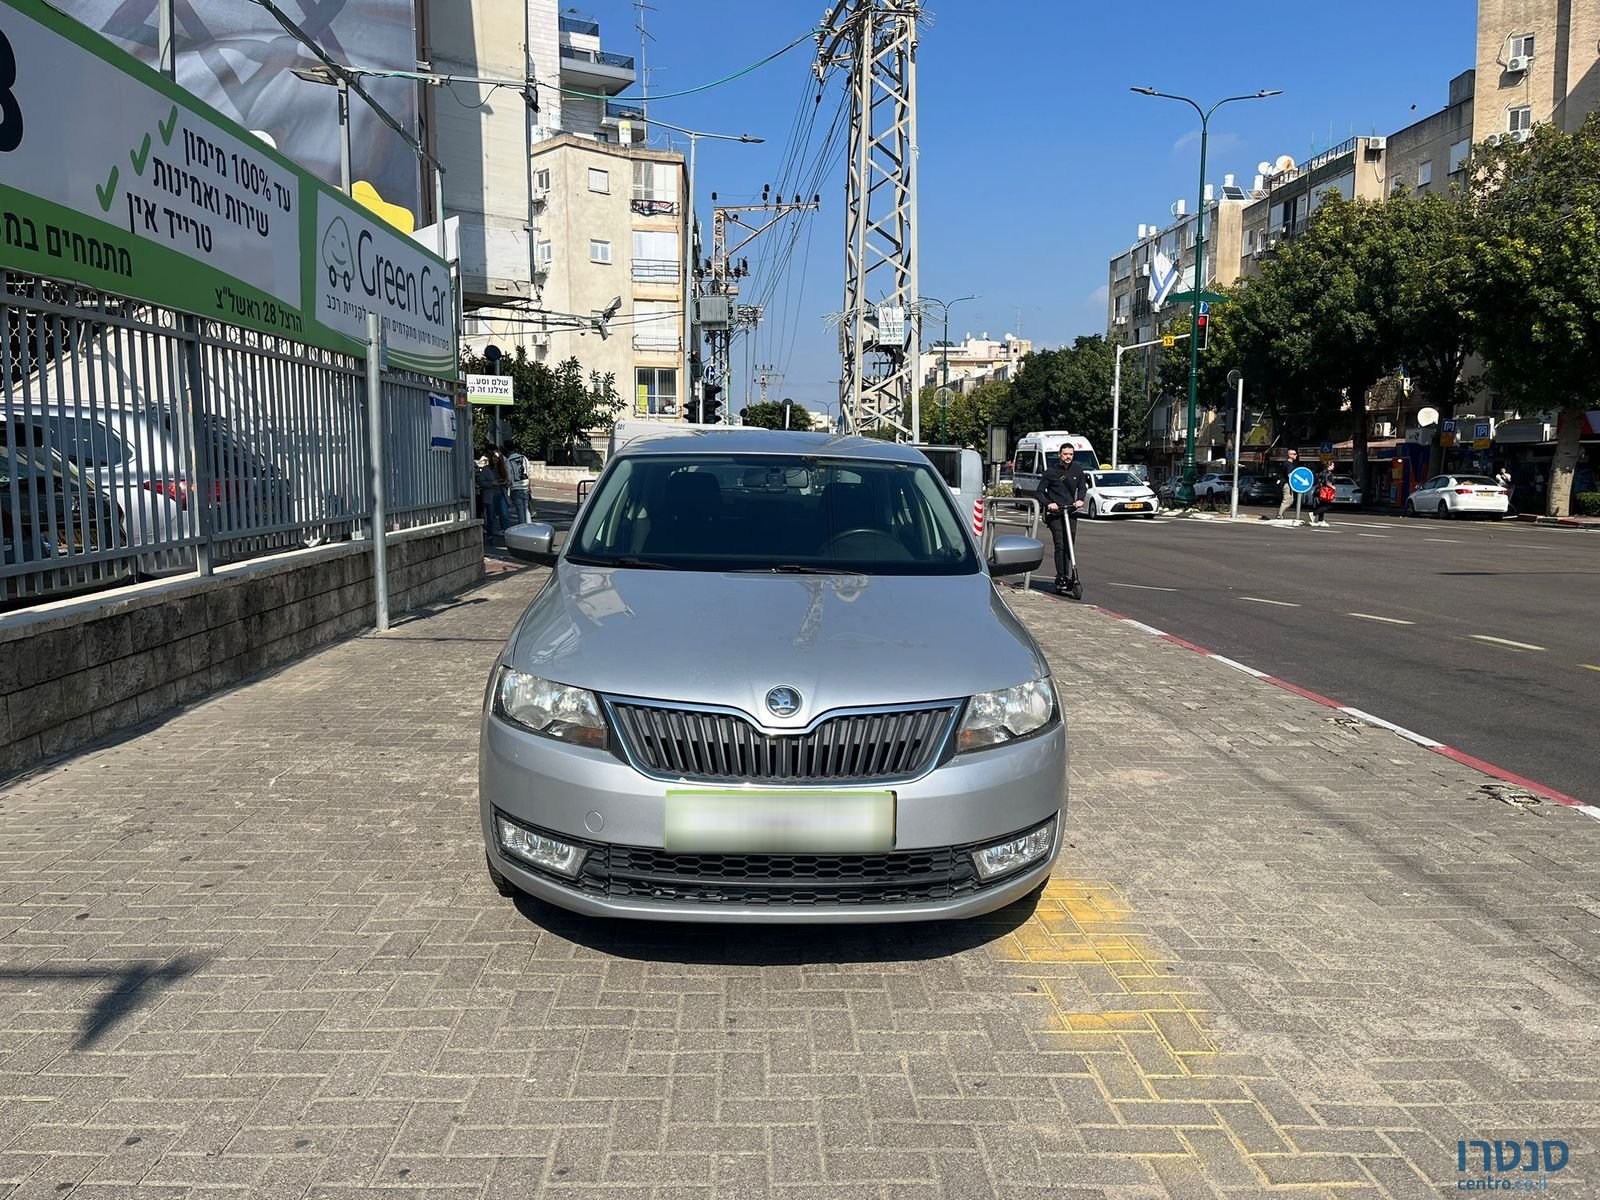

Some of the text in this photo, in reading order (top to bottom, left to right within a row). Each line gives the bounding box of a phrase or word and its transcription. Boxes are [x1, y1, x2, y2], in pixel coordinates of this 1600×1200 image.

[183, 127, 291, 213] עד 100% מימון
[153, 156, 269, 237] שירות ואמינות
[126, 191, 213, 253] טרייד אין
[0, 211, 133, 278] מתמחים במ
[357, 229, 446, 327] Green Car
[262, 301, 277, 325] 28
[326, 294, 341, 312] רכב
[278, 304, 302, 333] הרצל
[1165, 337, 1173, 345] 13
[488, 386, 509, 394] אצלנו
[491, 378, 509, 387] שלם
